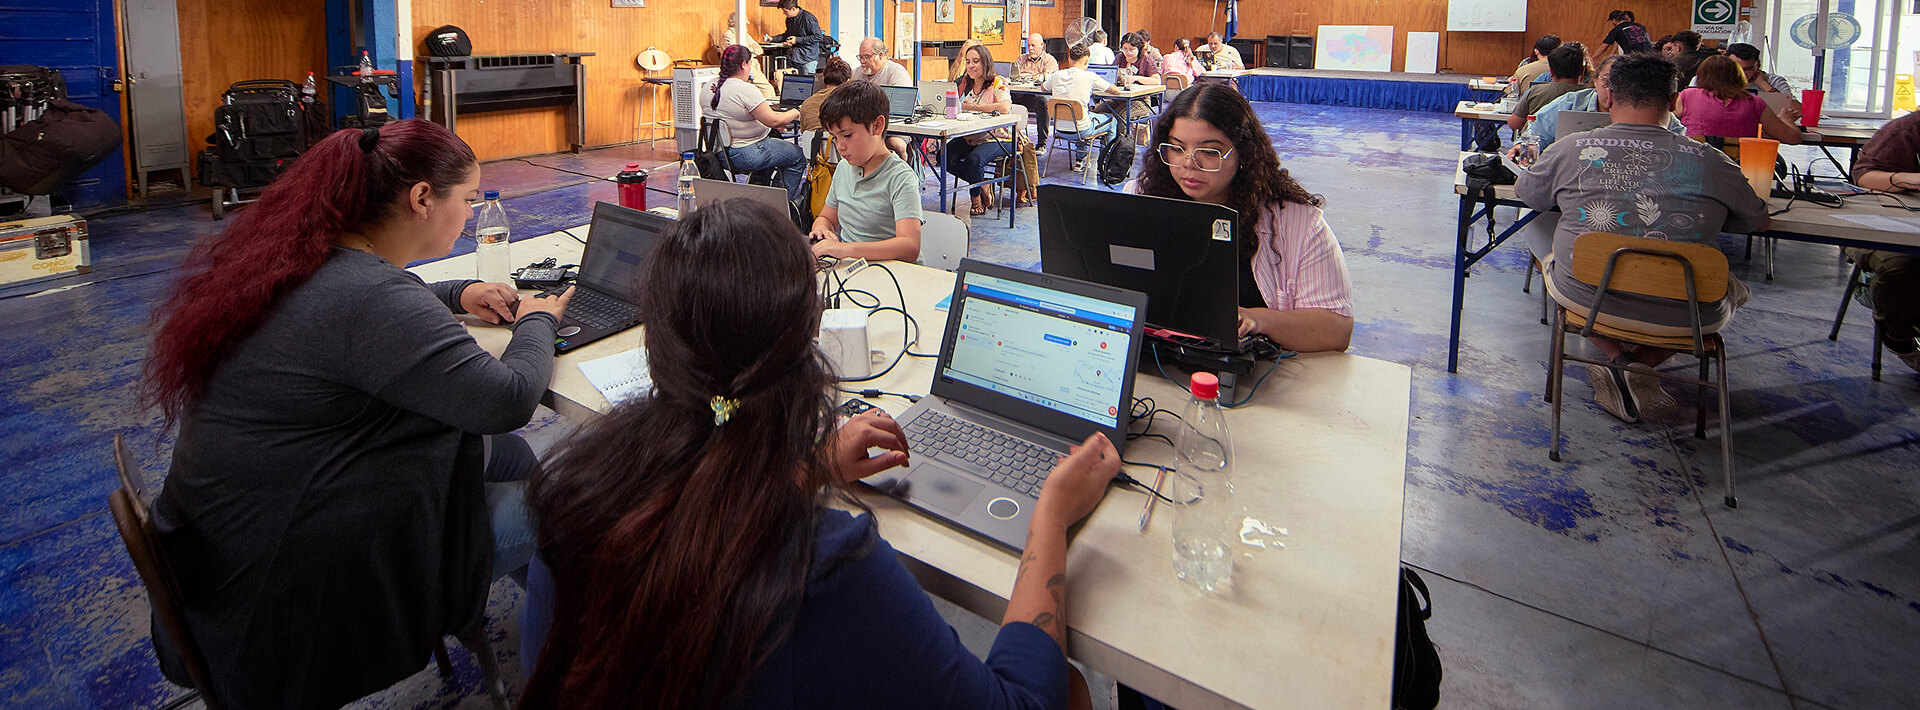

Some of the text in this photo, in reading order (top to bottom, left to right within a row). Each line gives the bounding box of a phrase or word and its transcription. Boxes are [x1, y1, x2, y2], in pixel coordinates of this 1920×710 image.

[1575, 138, 1705, 157] FINDING MY
[1601, 160, 1647, 171] YOU CAN
[1602, 167, 1641, 176] CREATE
[1600, 178, 1643, 188] LIFE YOU
[1604, 184, 1633, 192] WANT
[1214, 221, 1229, 238] 25
